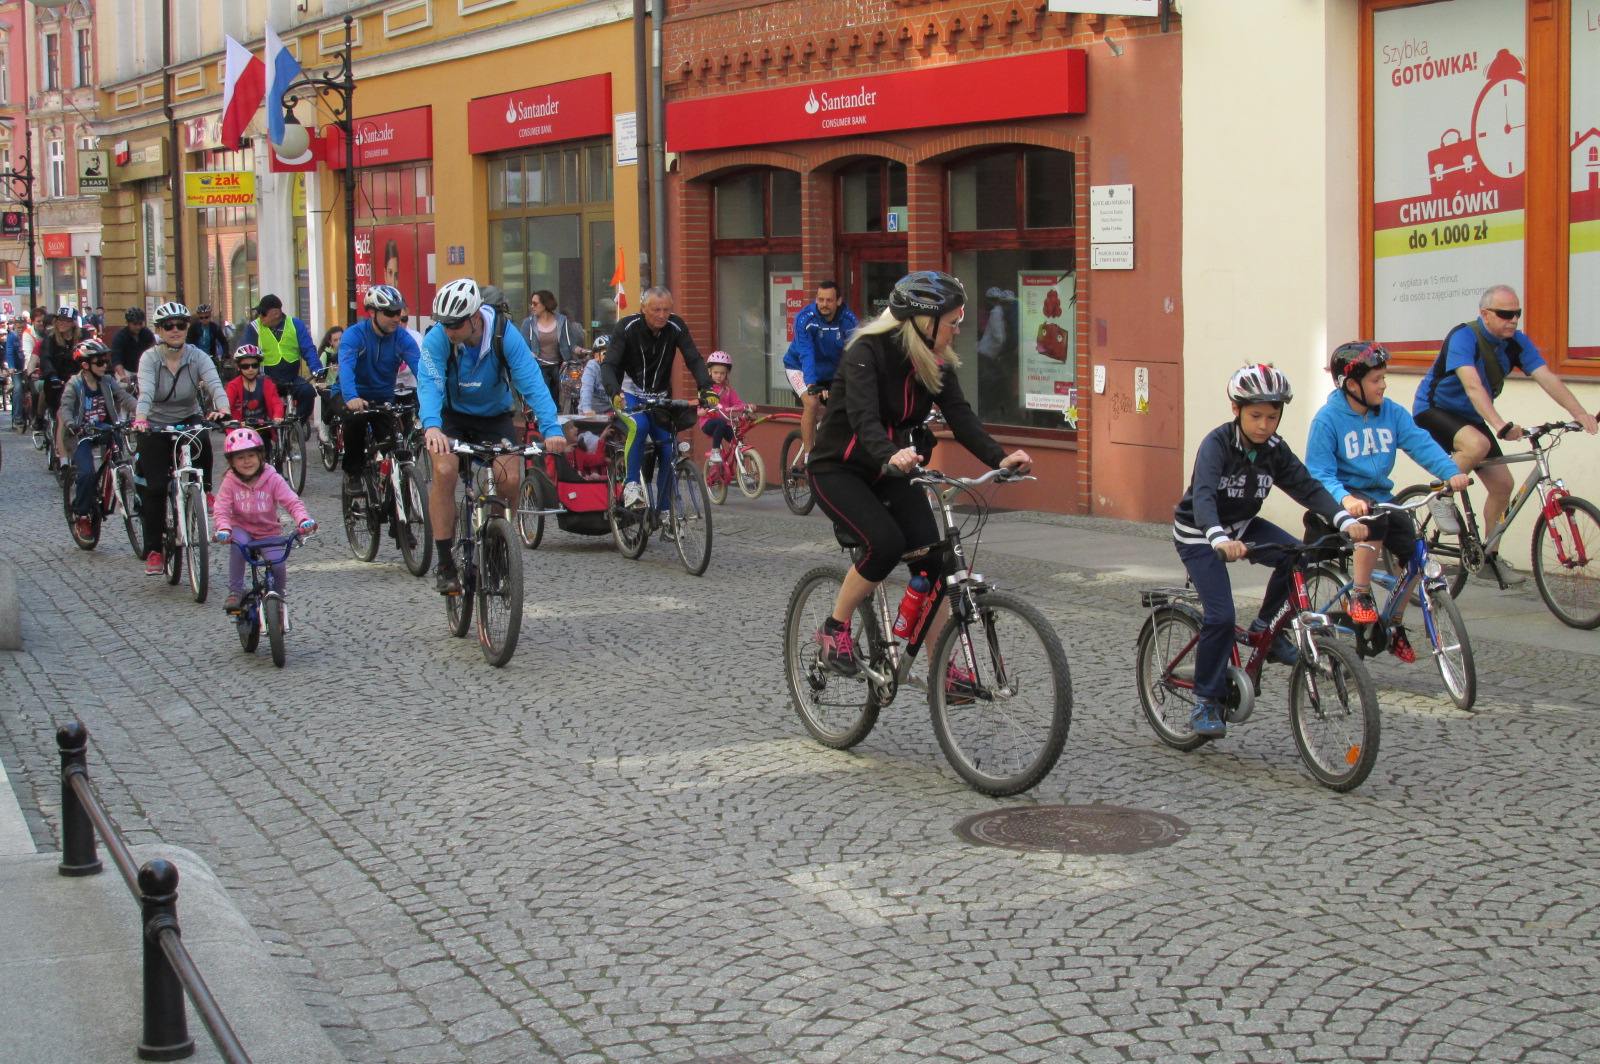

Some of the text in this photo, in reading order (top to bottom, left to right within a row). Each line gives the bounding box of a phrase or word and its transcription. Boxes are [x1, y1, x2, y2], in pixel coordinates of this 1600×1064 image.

[1587, 9, 1600, 31] L
[1383, 38, 1428, 66] Szybka
[1391, 51, 1477, 87] GOTÓWKA!
[518, 94, 559, 121] Santander
[821, 85, 876, 112] Santander
[364, 122, 394, 143] Santander
[519, 125, 552, 137] CONSUMER BANK
[822, 115, 867, 128] CONSUMER BANK
[215, 173, 240, 186] żak
[206, 193, 254, 204] DARMO!
[1400, 190, 1499, 223] CHWILÓWKI
[1408, 219, 1488, 249] do 1.000 zł
[1344, 427, 1393, 459] GAP
